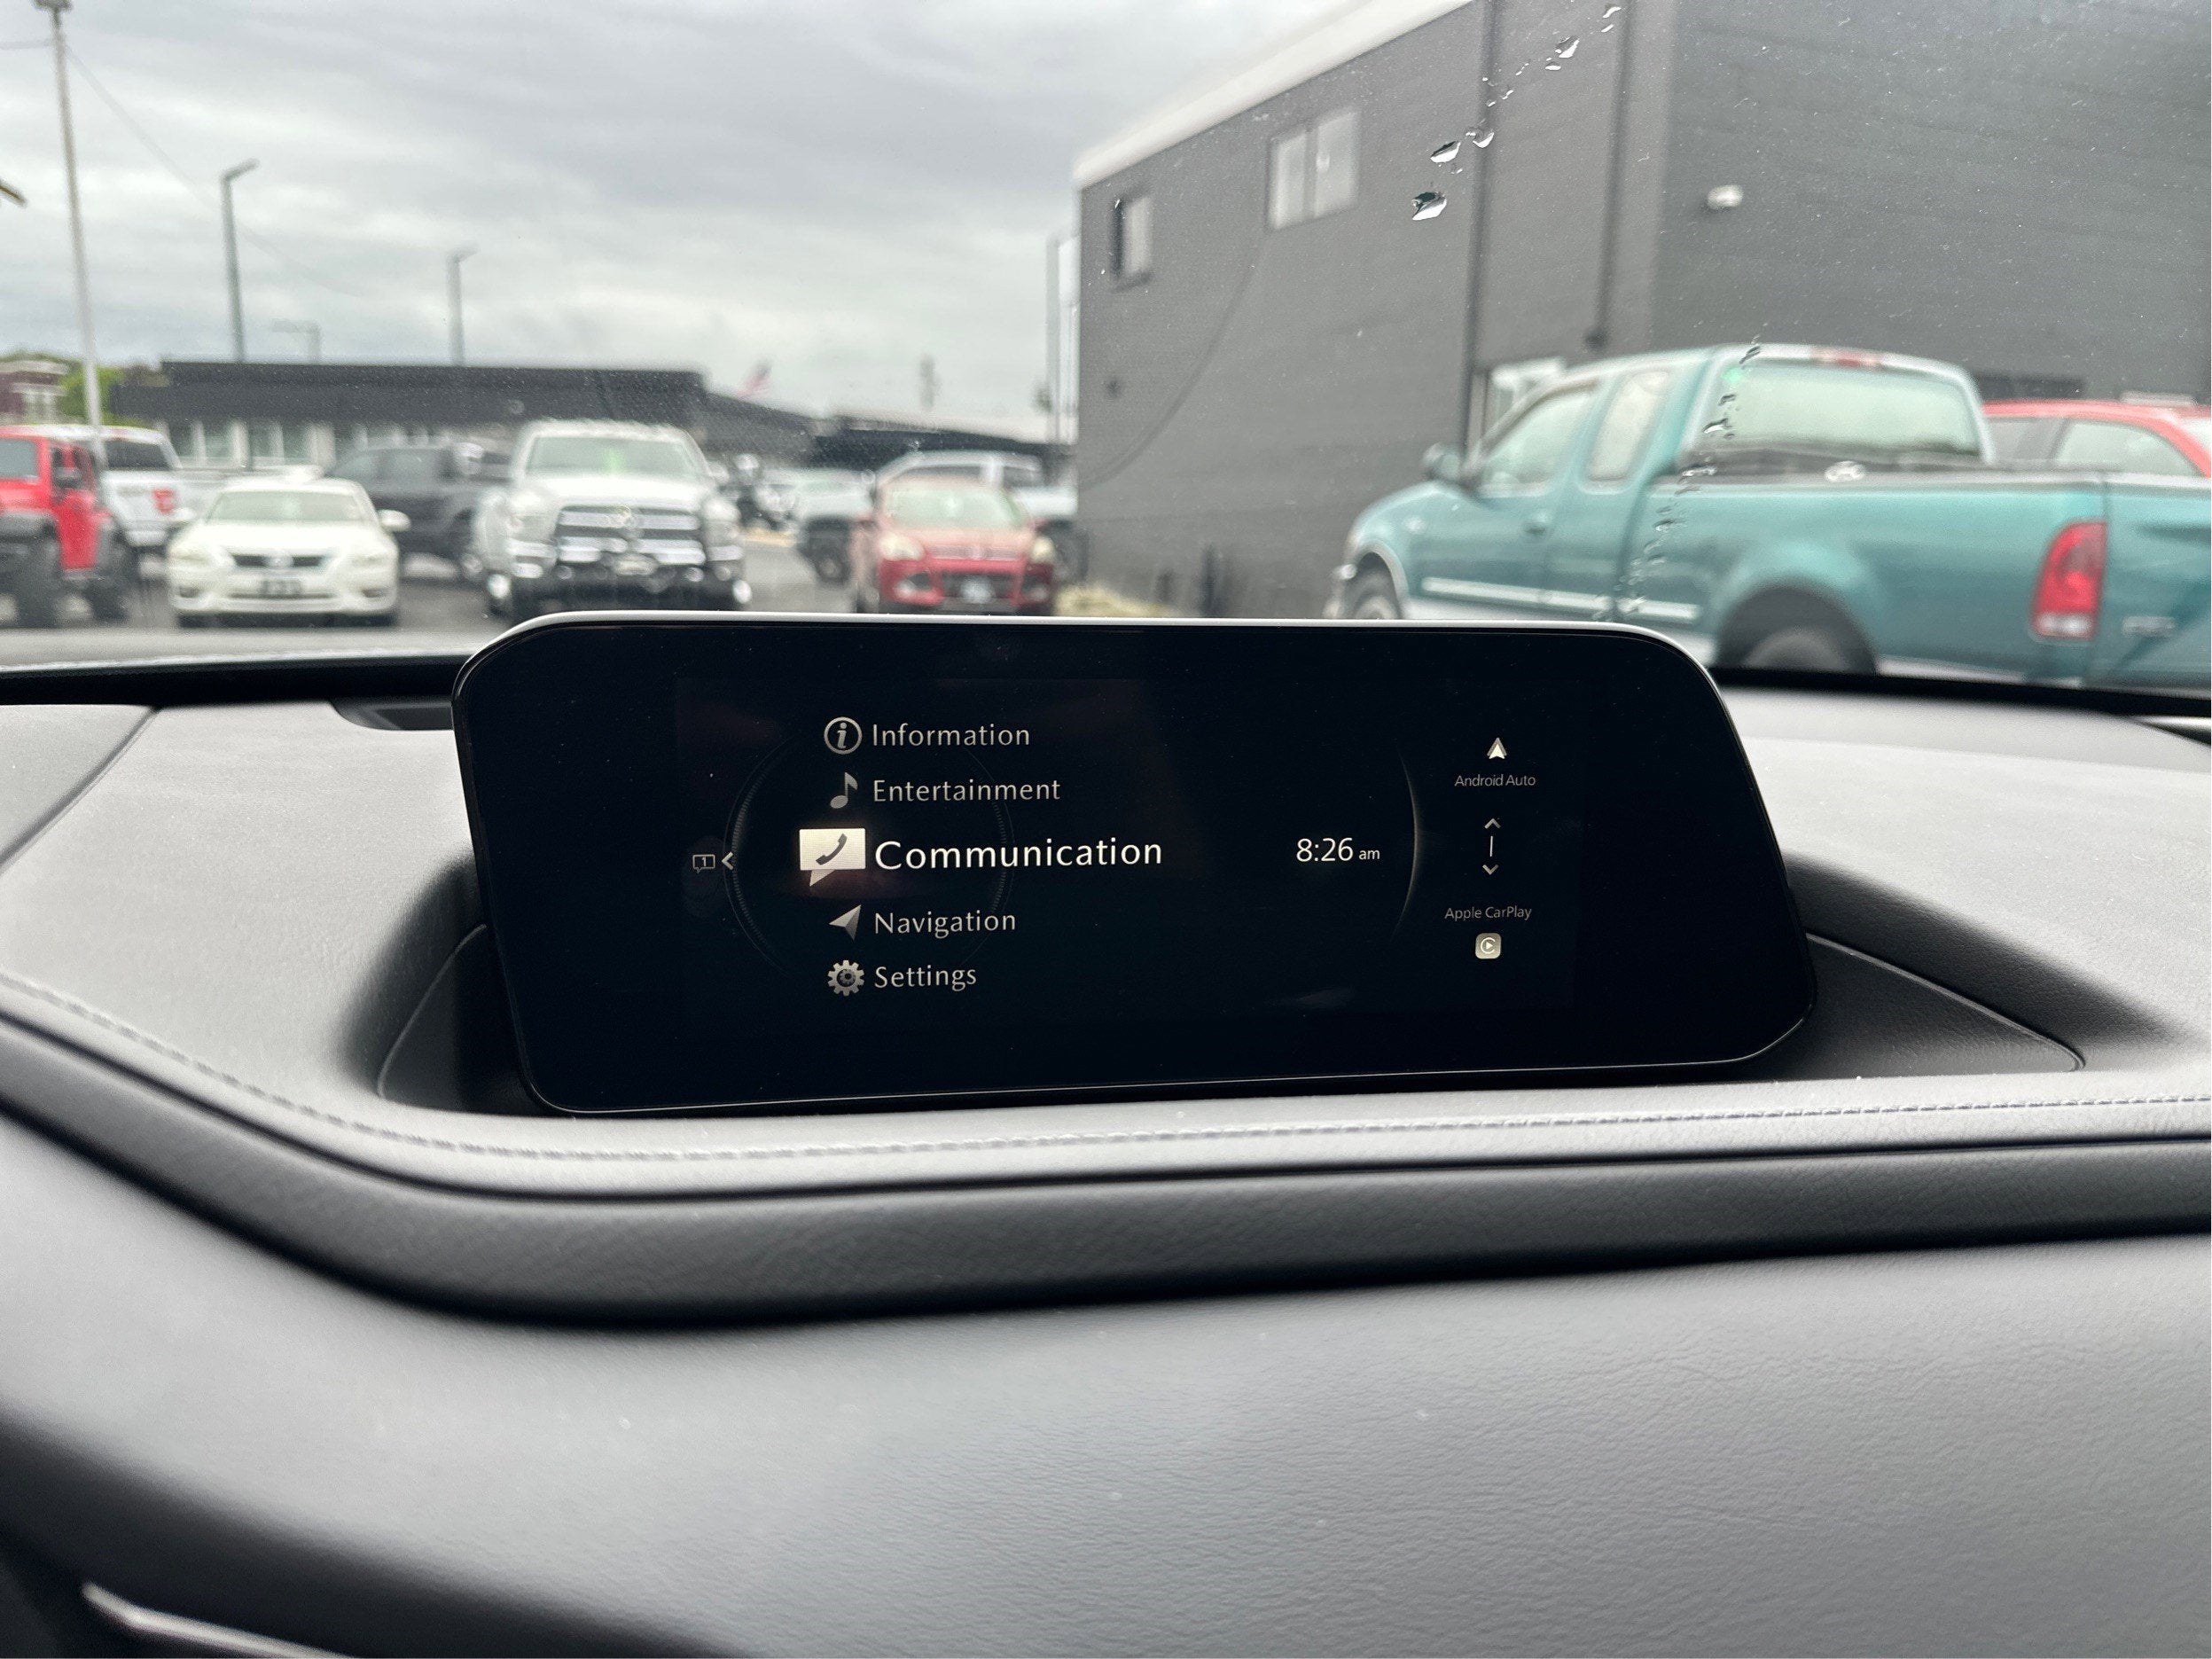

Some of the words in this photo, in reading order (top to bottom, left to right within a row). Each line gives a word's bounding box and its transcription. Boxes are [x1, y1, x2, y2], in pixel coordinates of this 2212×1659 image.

[872, 723, 1030, 746] Information
[873, 779, 1061, 802] Entertainment
[1454, 774, 1504, 786] Android
[1505, 774, 1536, 786] Auto
[874, 836, 1163, 870] Communication
[1296, 837, 1354, 862] 8:26
[1358, 848, 1380, 860] am
[873, 911, 1017, 939] Navigation
[1444, 907, 1482, 921] Apple
[1485, 906, 1532, 920] CarPlay
[873, 965, 978, 992] Settings
